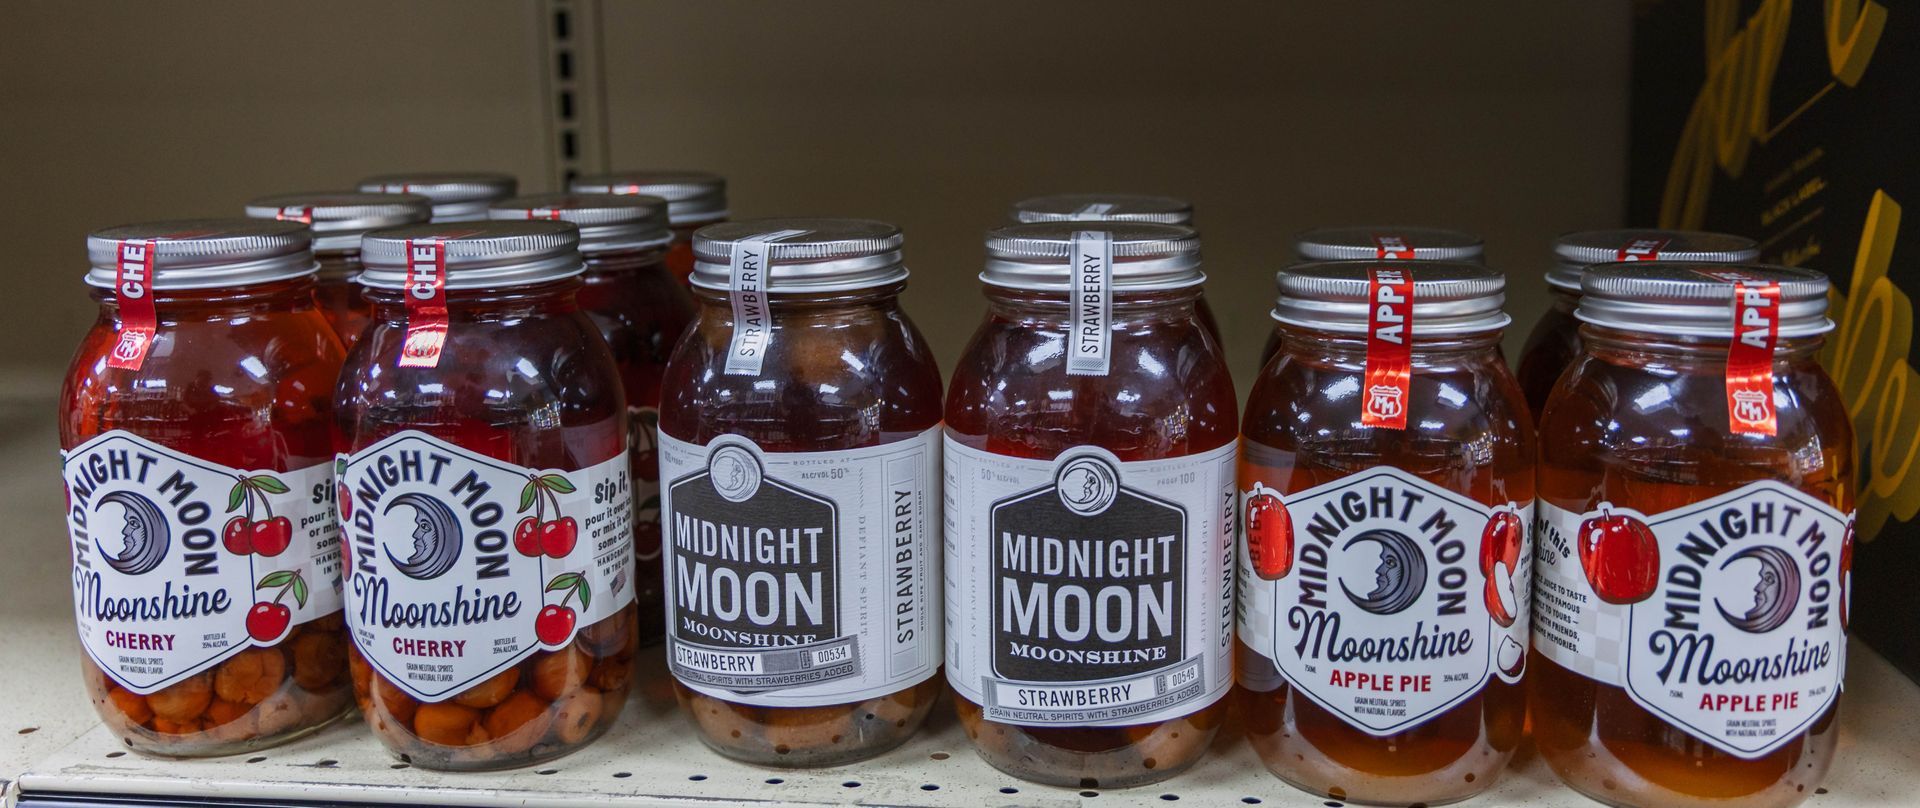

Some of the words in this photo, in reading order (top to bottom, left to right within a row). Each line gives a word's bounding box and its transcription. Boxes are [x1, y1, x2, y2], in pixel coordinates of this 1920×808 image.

[122, 239, 146, 299] CHE
[412, 239, 436, 300] CHE
[740, 250, 761, 357] STRAWBERRY
[1082, 254, 1101, 354] STRAWBERRY
[594, 477, 616, 504] Sip
[1180, 472, 1195, 484] 100
[74, 449, 158, 569] MIDNIGHT
[157, 470, 220, 576] MOON
[300, 510, 326, 528] pour
[328, 507, 336, 518] it
[354, 450, 452, 574] MIDNIGHT
[450, 469, 510, 580] MOON
[585, 511, 606, 530] pour
[606, 507, 612, 518] it
[614, 501, 626, 515] over
[309, 527, 320, 538] or
[592, 526, 601, 538] or
[603, 520, 616, 534] mix
[616, 516, 622, 529] it
[676, 512, 824, 564] MIDNIGHT
[598, 537, 617, 551] some
[1002, 532, 1176, 578] MIDNIGHT
[1298, 486, 1424, 609] MIDNIGHT
[1418, 508, 1467, 616] MOON
[1550, 526, 1570, 558] this
[324, 566, 332, 575] IN
[603, 566, 610, 576] IN
[612, 562, 621, 572] THE
[894, 490, 914, 644] STRAWBERRY
[1222, 490, 1233, 648] STRAWBERRY
[1664, 502, 1802, 632] MIDNIGHT
[1796, 520, 1832, 630] MOON
[75, 566, 232, 622] Moonshine
[354, 573, 522, 628] Moonshine
[677, 554, 823, 626] MOON
[1558, 584, 1566, 595] TO
[1566, 588, 1587, 604] TASTE
[1002, 577, 1174, 643] MOON
[1552, 608, 1571, 624] YOURS
[1555, 598, 1580, 614] FAMOUS
[106, 630, 176, 651] CHERRY
[684, 616, 817, 647] MOONSHINE
[1288, 605, 1474, 663] Moonshine
[1546, 632, 1580, 654] MEMORIES.
[1552, 619, 1580, 642] FRIENDS,
[393, 638, 466, 658] CHERRY
[677, 645, 755, 672] STRAWBERRY
[818, 646, 846, 663] 00534
[1010, 641, 1167, 665] MOONSHINE
[1648, 629, 1832, 686] Moonshine
[707, 674, 733, 684] SPIRITS
[756, 672, 821, 685] STRAWBERRIES
[824, 664, 854, 678] ADDED
[1172, 670, 1195, 686] 00549
[1330, 669, 1394, 692] APPLE
[1400, 675, 1432, 692] PIE
[990, 708, 1010, 718] GRAIN
[1012, 712, 1048, 721] NEUTRAL
[1050, 713, 1084, 721] SPIRITS
[1088, 710, 1108, 720] WITH
[1112, 697, 1174, 717] STRAWBERRIES
[1176, 684, 1200, 701] ADDED
[1018, 684, 1132, 707] STRAWBERRY
[1354, 696, 1368, 705] GRAIN
[1368, 698, 1389, 706] NEUTRAL
[1699, 694, 1766, 712] APPLE
[1772, 692, 1798, 710] PIE
[1354, 706, 1366, 714] WITH
[1366, 708, 1386, 716] NATURAL
